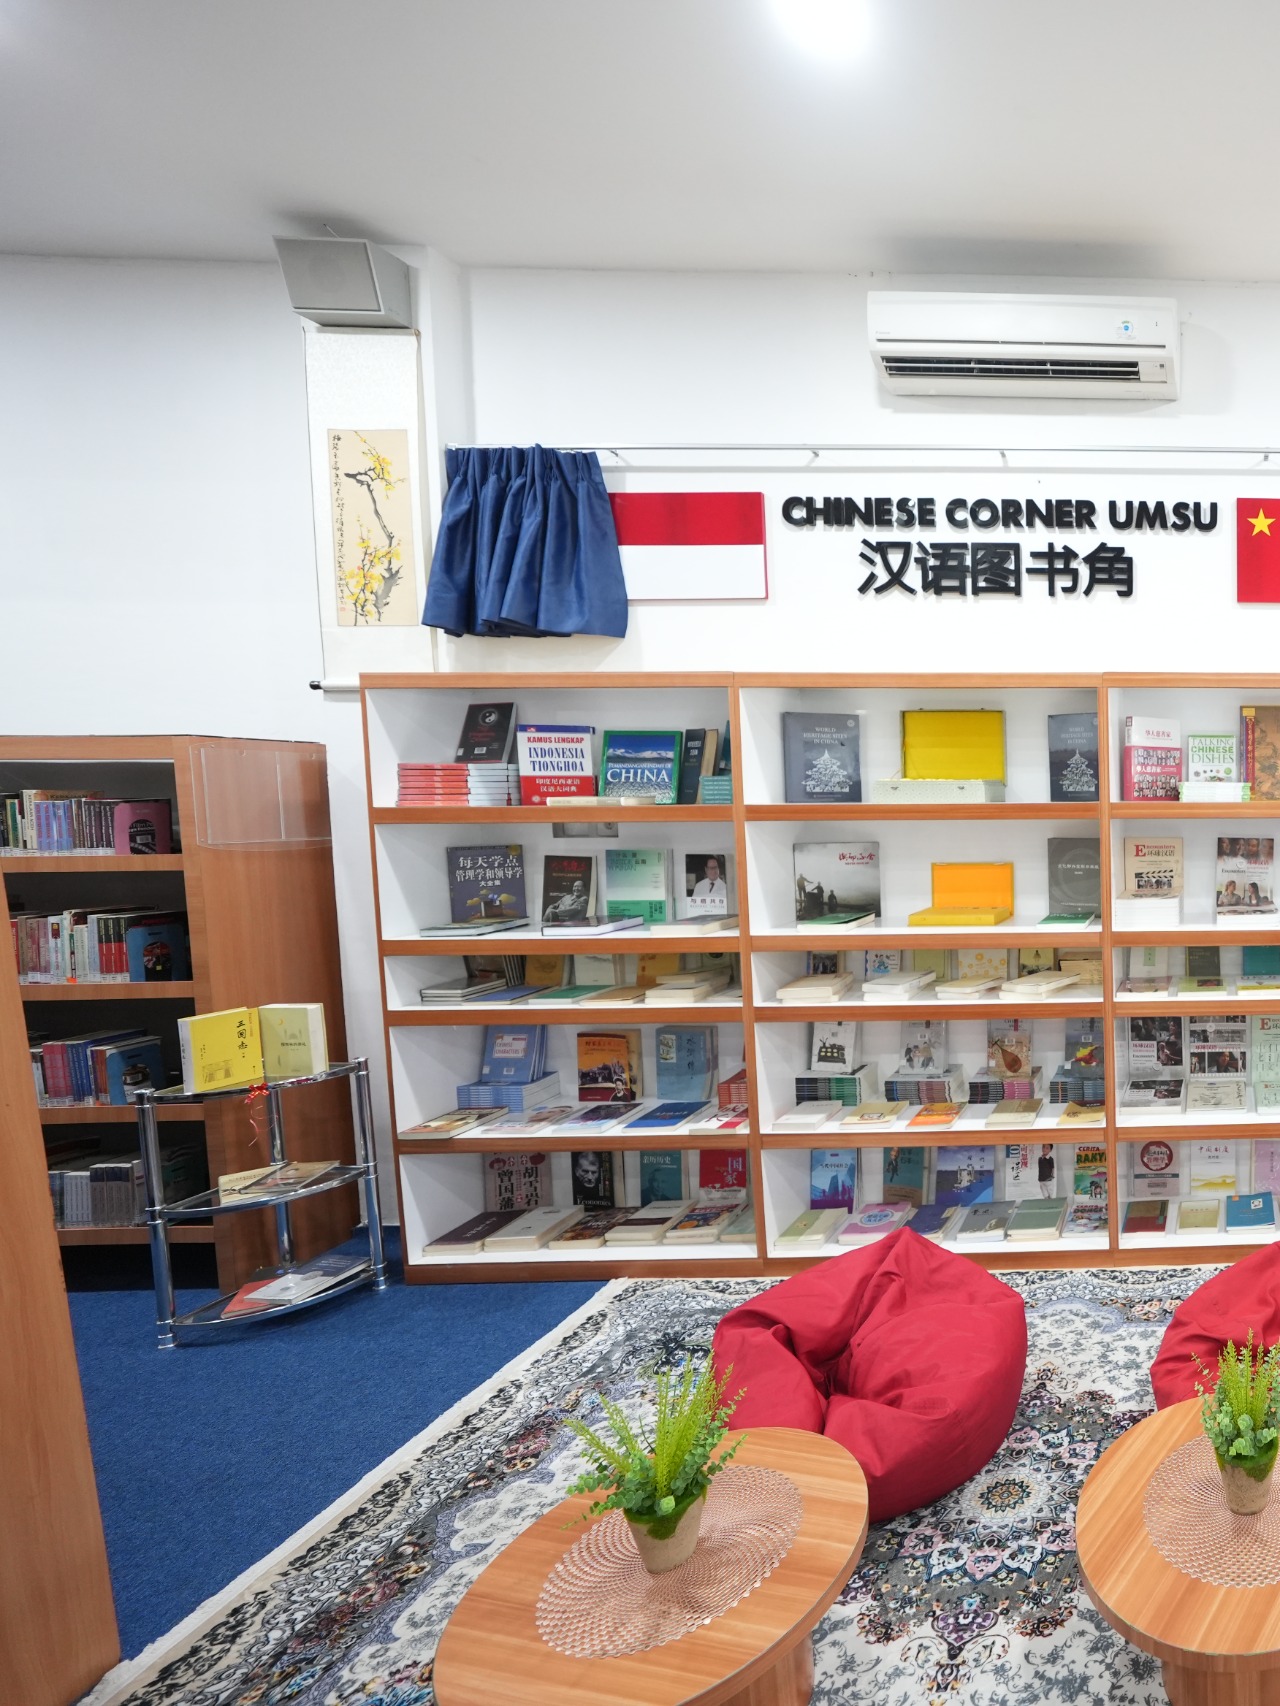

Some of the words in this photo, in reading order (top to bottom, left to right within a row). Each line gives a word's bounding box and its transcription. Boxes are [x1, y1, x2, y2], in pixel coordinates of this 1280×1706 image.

[781, 496, 936, 529] CHINESE
[945, 498, 1096, 530] CORNER
[1109, 500, 1219, 532] UMSU
[857, 538, 1135, 598] 汉语图书角
[527, 736, 553, 744] KAMUS
[554, 736, 585, 744] LENGKAP
[1190, 738, 1235, 746] TALKING
[528, 747, 585, 759] INDONESIA
[1190, 746, 1235, 754] CHINESE
[1191, 753, 1235, 764] DISHES
[530, 760, 585, 772] TIONGHOA
[606, 768, 670, 783] CHINA
[459, 855, 519, 869] 每天学点
[455, 867, 523, 882] 管理学和领导学
[479, 879, 501, 887] 大全集
[497, 1169, 514, 1210] 曾国藩
[523, 1166, 540, 1207] 胡雪岩
[577, 1197, 612, 1207] Economics
